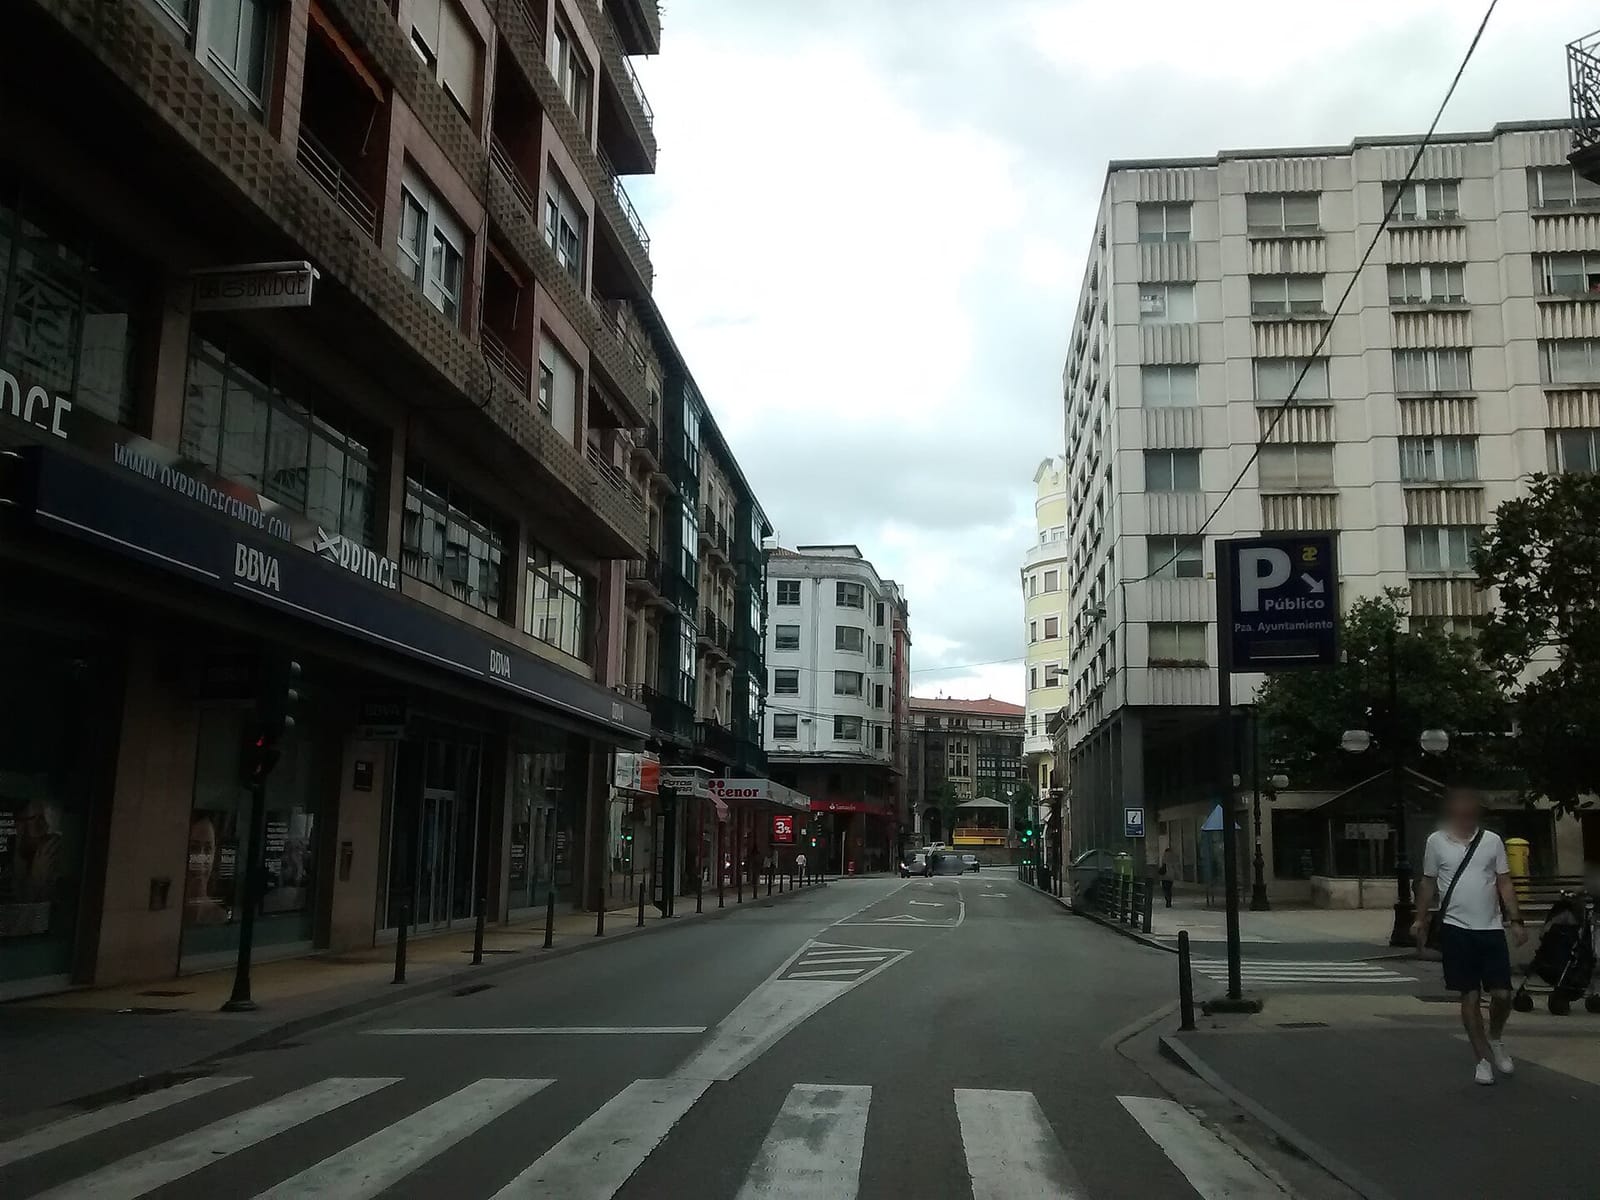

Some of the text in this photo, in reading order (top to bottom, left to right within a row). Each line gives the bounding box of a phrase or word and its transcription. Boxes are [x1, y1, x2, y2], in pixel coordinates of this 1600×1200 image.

[234, 542, 281, 592] BBVA
[1239, 547, 1291, 612] P
[1265, 597, 1325, 611] Público
[1258, 620, 1333, 633] Ayuntamiento
[489, 649, 511, 679] BBVA
[717, 787, 760, 798] cenor
